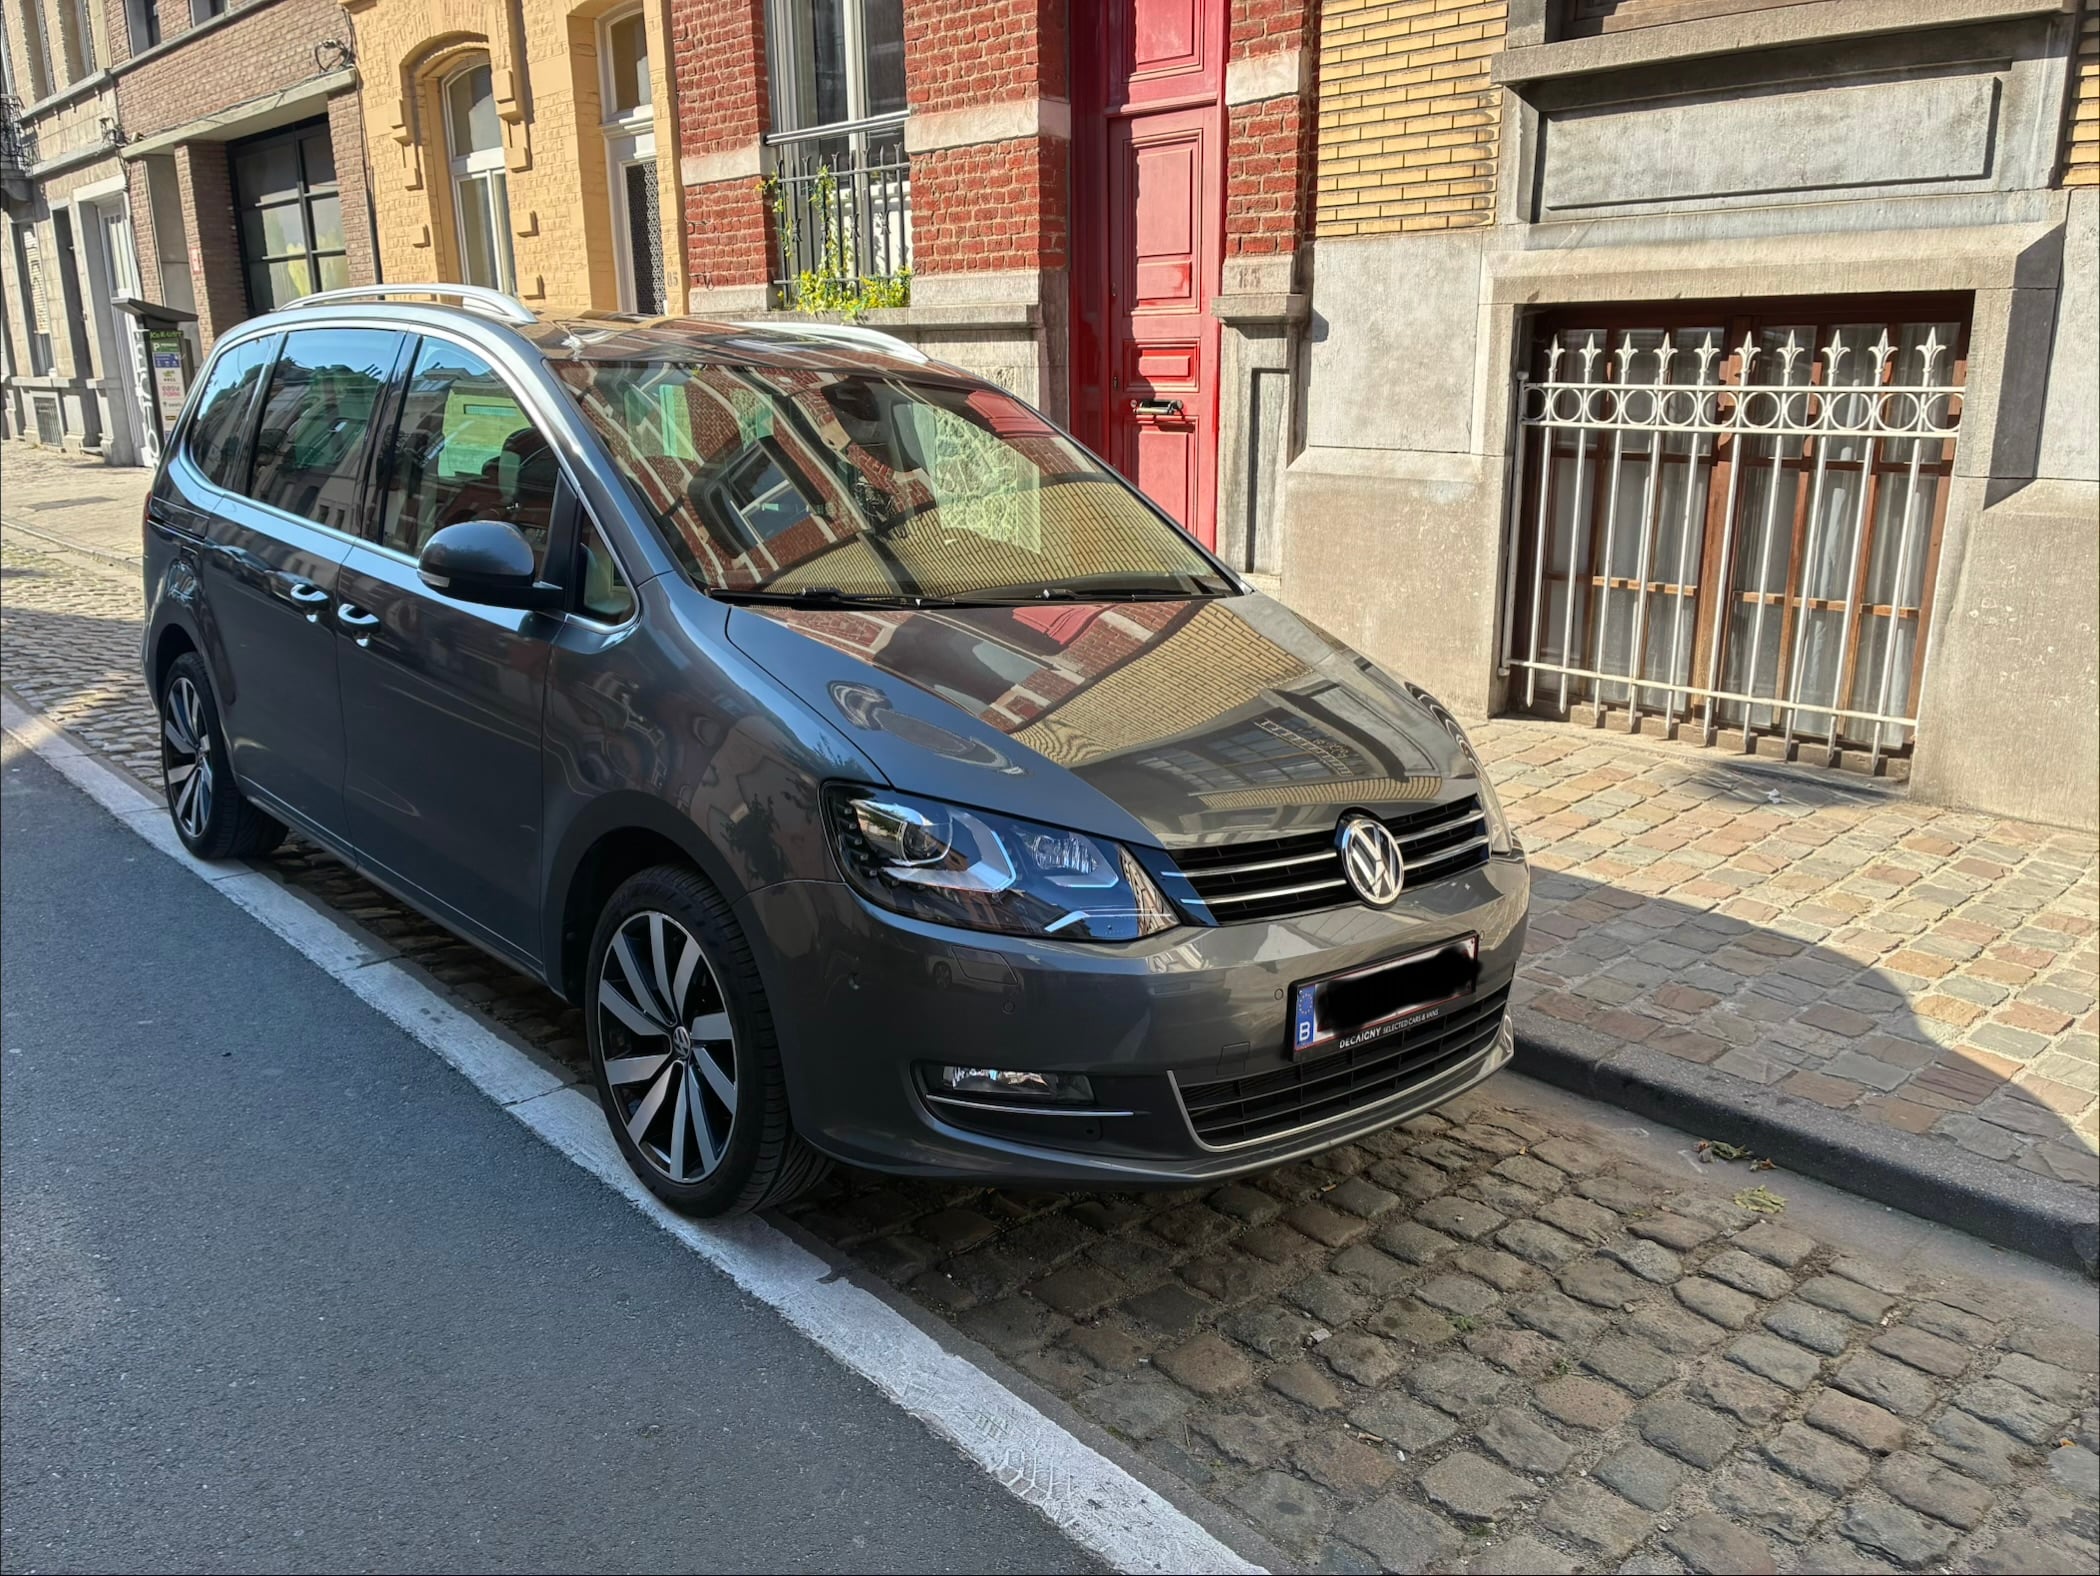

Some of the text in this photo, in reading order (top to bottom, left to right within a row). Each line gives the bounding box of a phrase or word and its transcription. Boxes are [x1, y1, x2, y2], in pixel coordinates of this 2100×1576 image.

[153, 342, 161, 352] P
[1299, 1021, 1311, 1042] B
[1339, 1027, 1382, 1048] DECAIGNY
[1383, 1019, 1409, 1034] SELECTED
